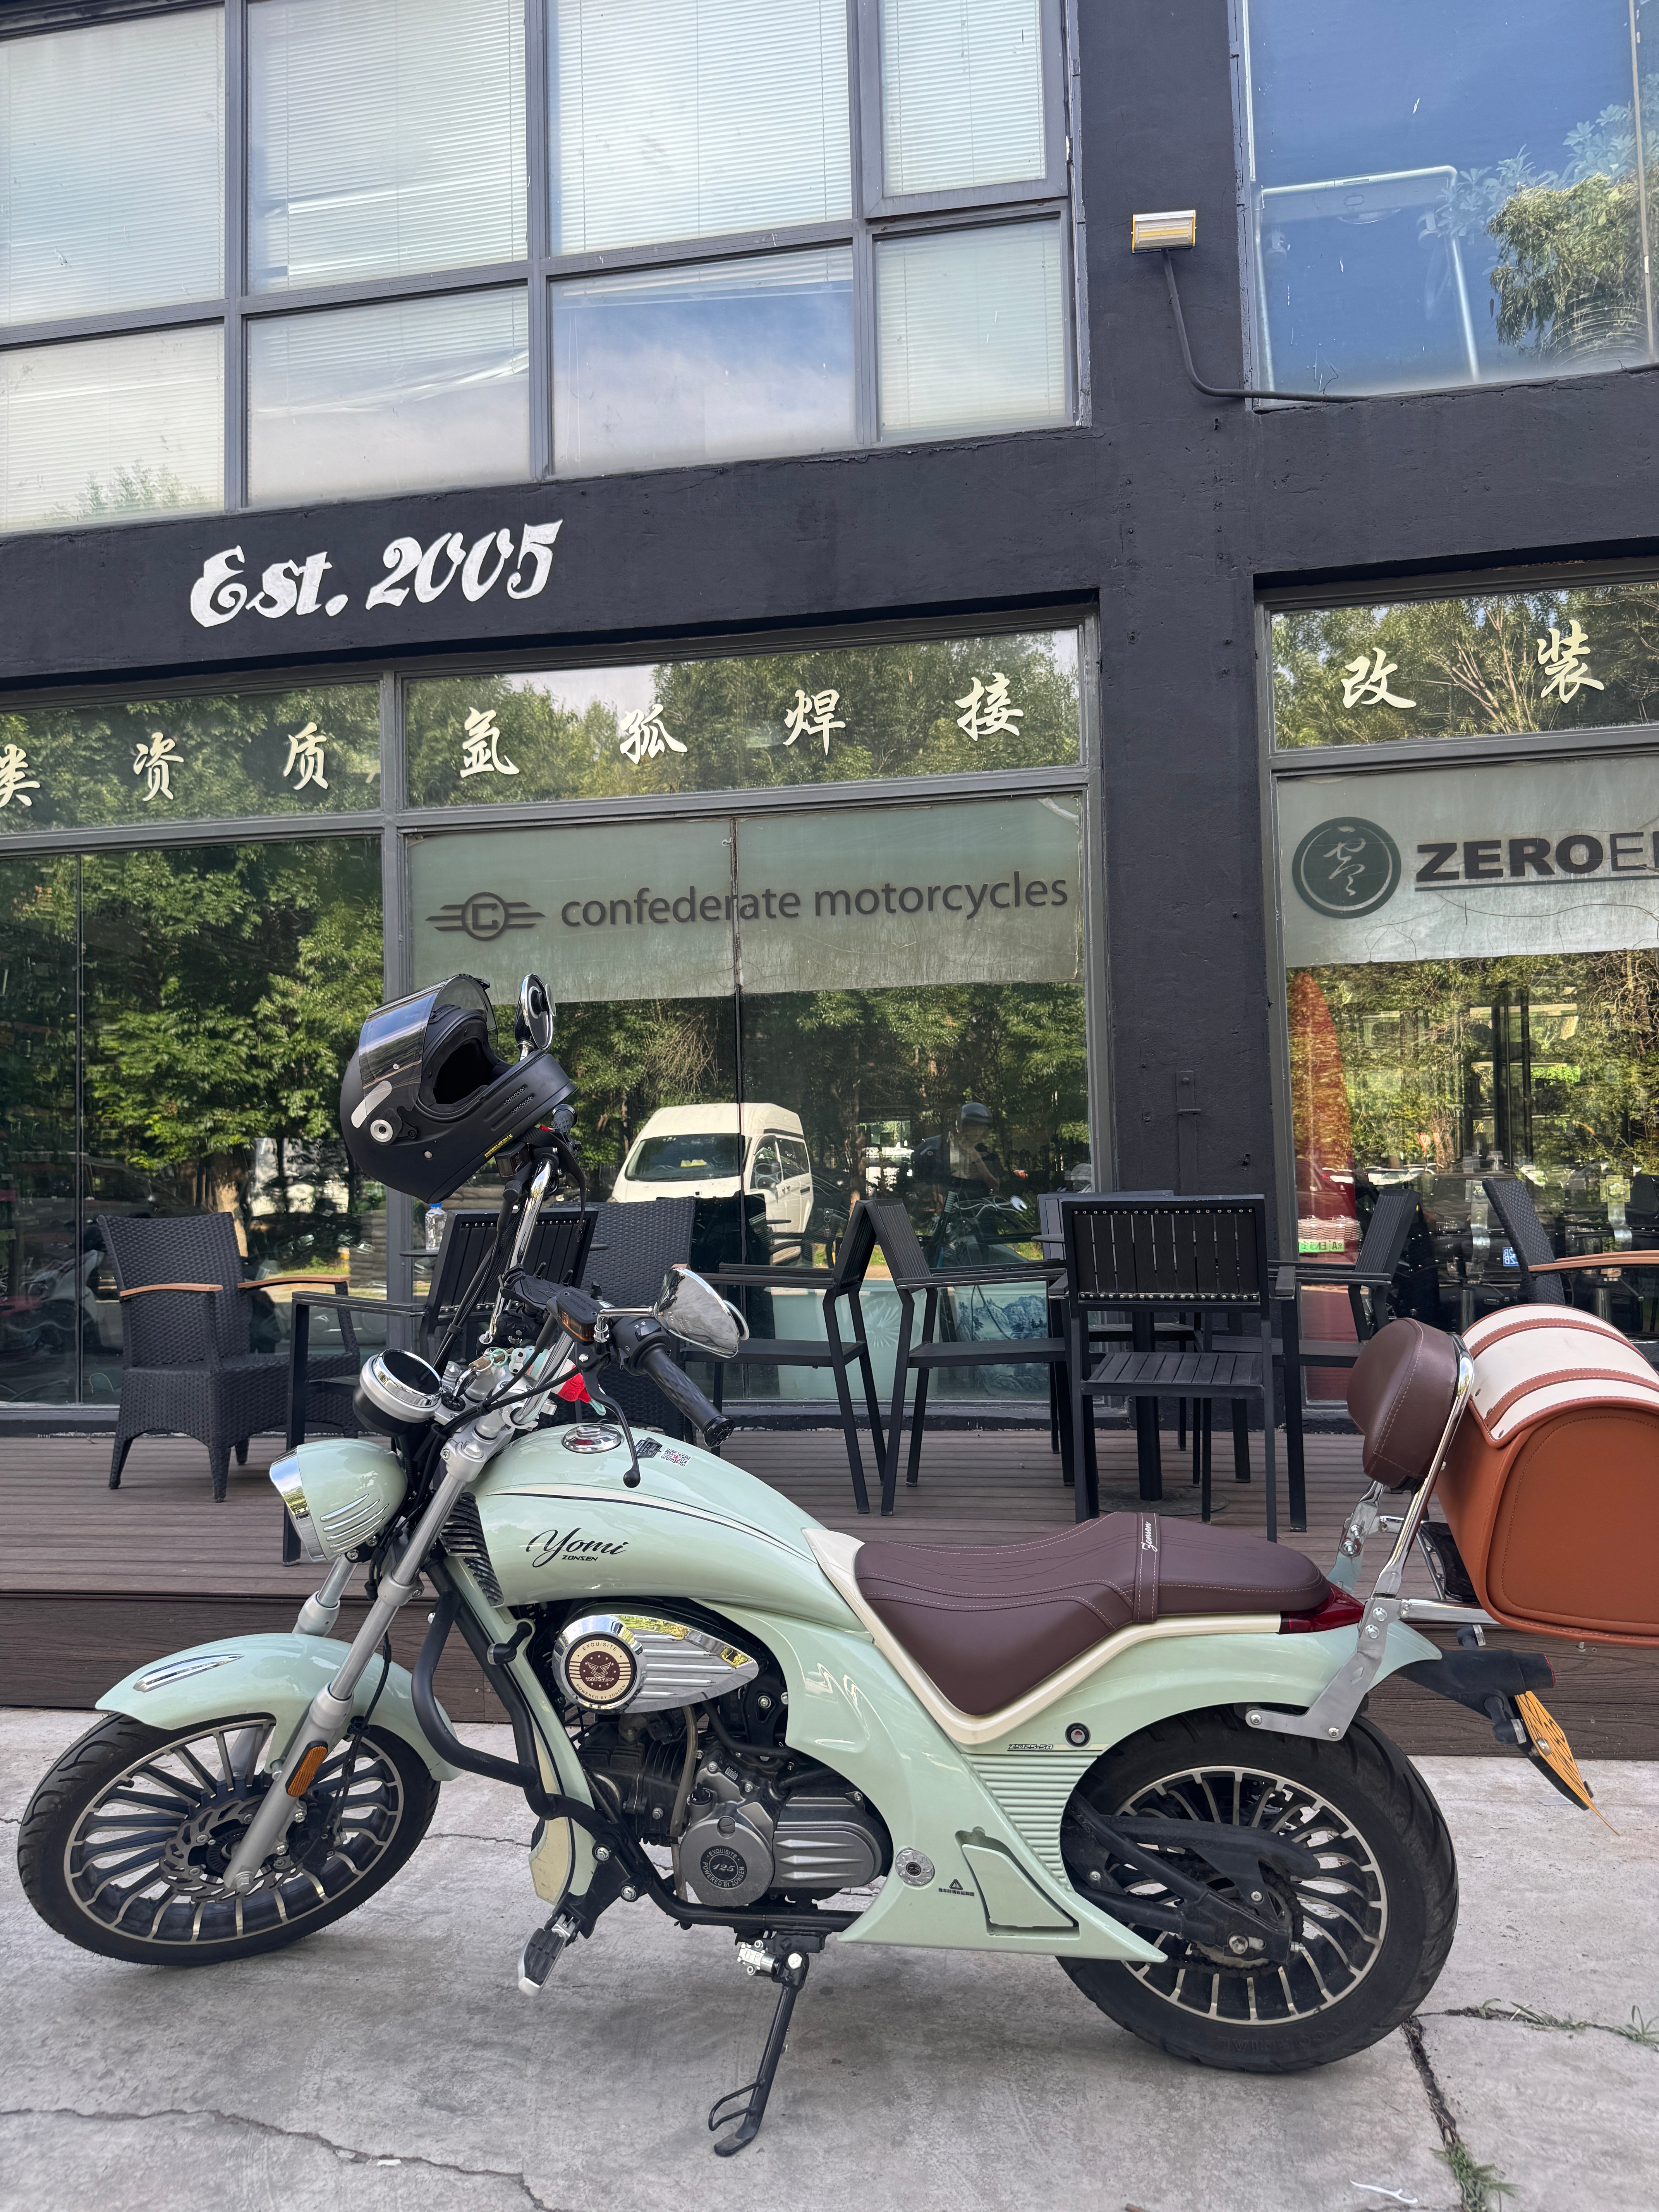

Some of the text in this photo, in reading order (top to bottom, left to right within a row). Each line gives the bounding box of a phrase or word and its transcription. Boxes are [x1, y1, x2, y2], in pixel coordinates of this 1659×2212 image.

[190, 519, 564, 628] Est. 2005
[1342, 619, 1605, 709] 改装
[1415, 831, 1659, 882] ZEROE
[562, 871, 1068, 928] confederate motorcycles
[526, 1527, 630, 1568] Yomi
[582, 1642, 617, 1652] EXQUISITE
[576, 1684, 599, 1699] POWERED
[609, 1684, 626, 1698] ZONSEN
[709, 1848, 738, 1859] EXQUISITE
[712, 1863, 735, 1872] 125
[703, 1862, 722, 1886] POWERED
[730, 1867, 745, 1886] ZONSEN
